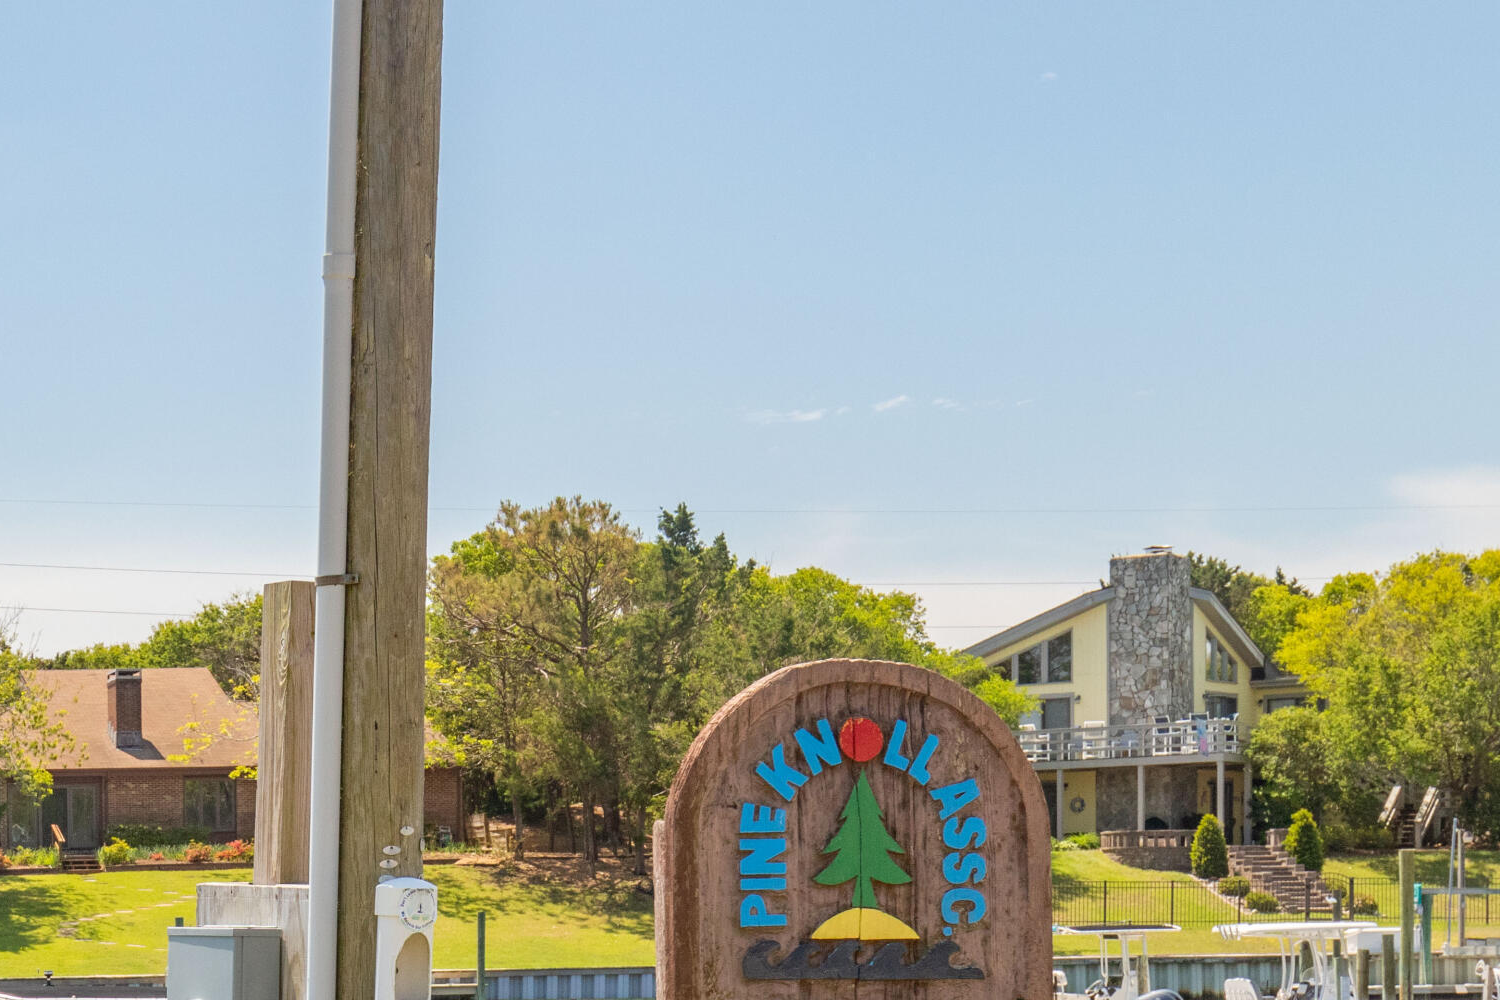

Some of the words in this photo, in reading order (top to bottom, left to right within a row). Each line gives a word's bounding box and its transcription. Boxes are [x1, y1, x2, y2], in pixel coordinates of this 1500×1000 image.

[755, 718, 940, 802] KNOLL
[739, 802, 788, 928] PINE
[929, 778, 988, 937] ASSC.
